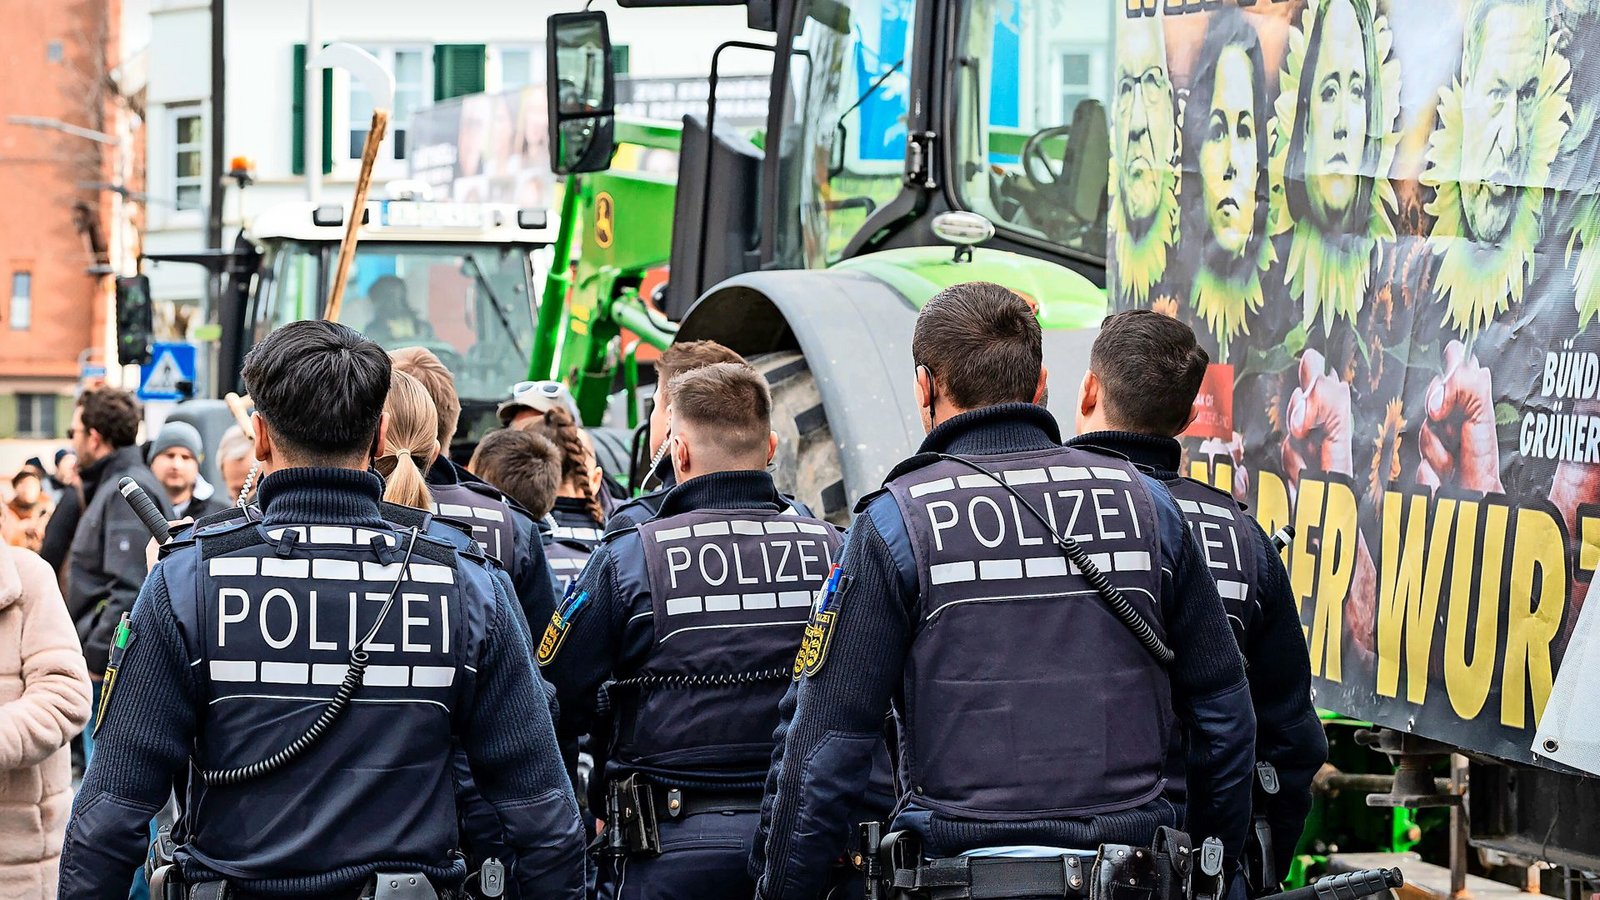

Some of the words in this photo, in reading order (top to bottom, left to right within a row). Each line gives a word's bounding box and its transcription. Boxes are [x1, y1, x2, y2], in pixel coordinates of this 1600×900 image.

[1541, 338, 1600, 400] BÜND
[926, 487, 1141, 551] POLIZEI
[666, 540, 832, 589] POLIZEI
[218, 587, 450, 654] POLIZEI
[1377, 490, 1600, 730] WUR
